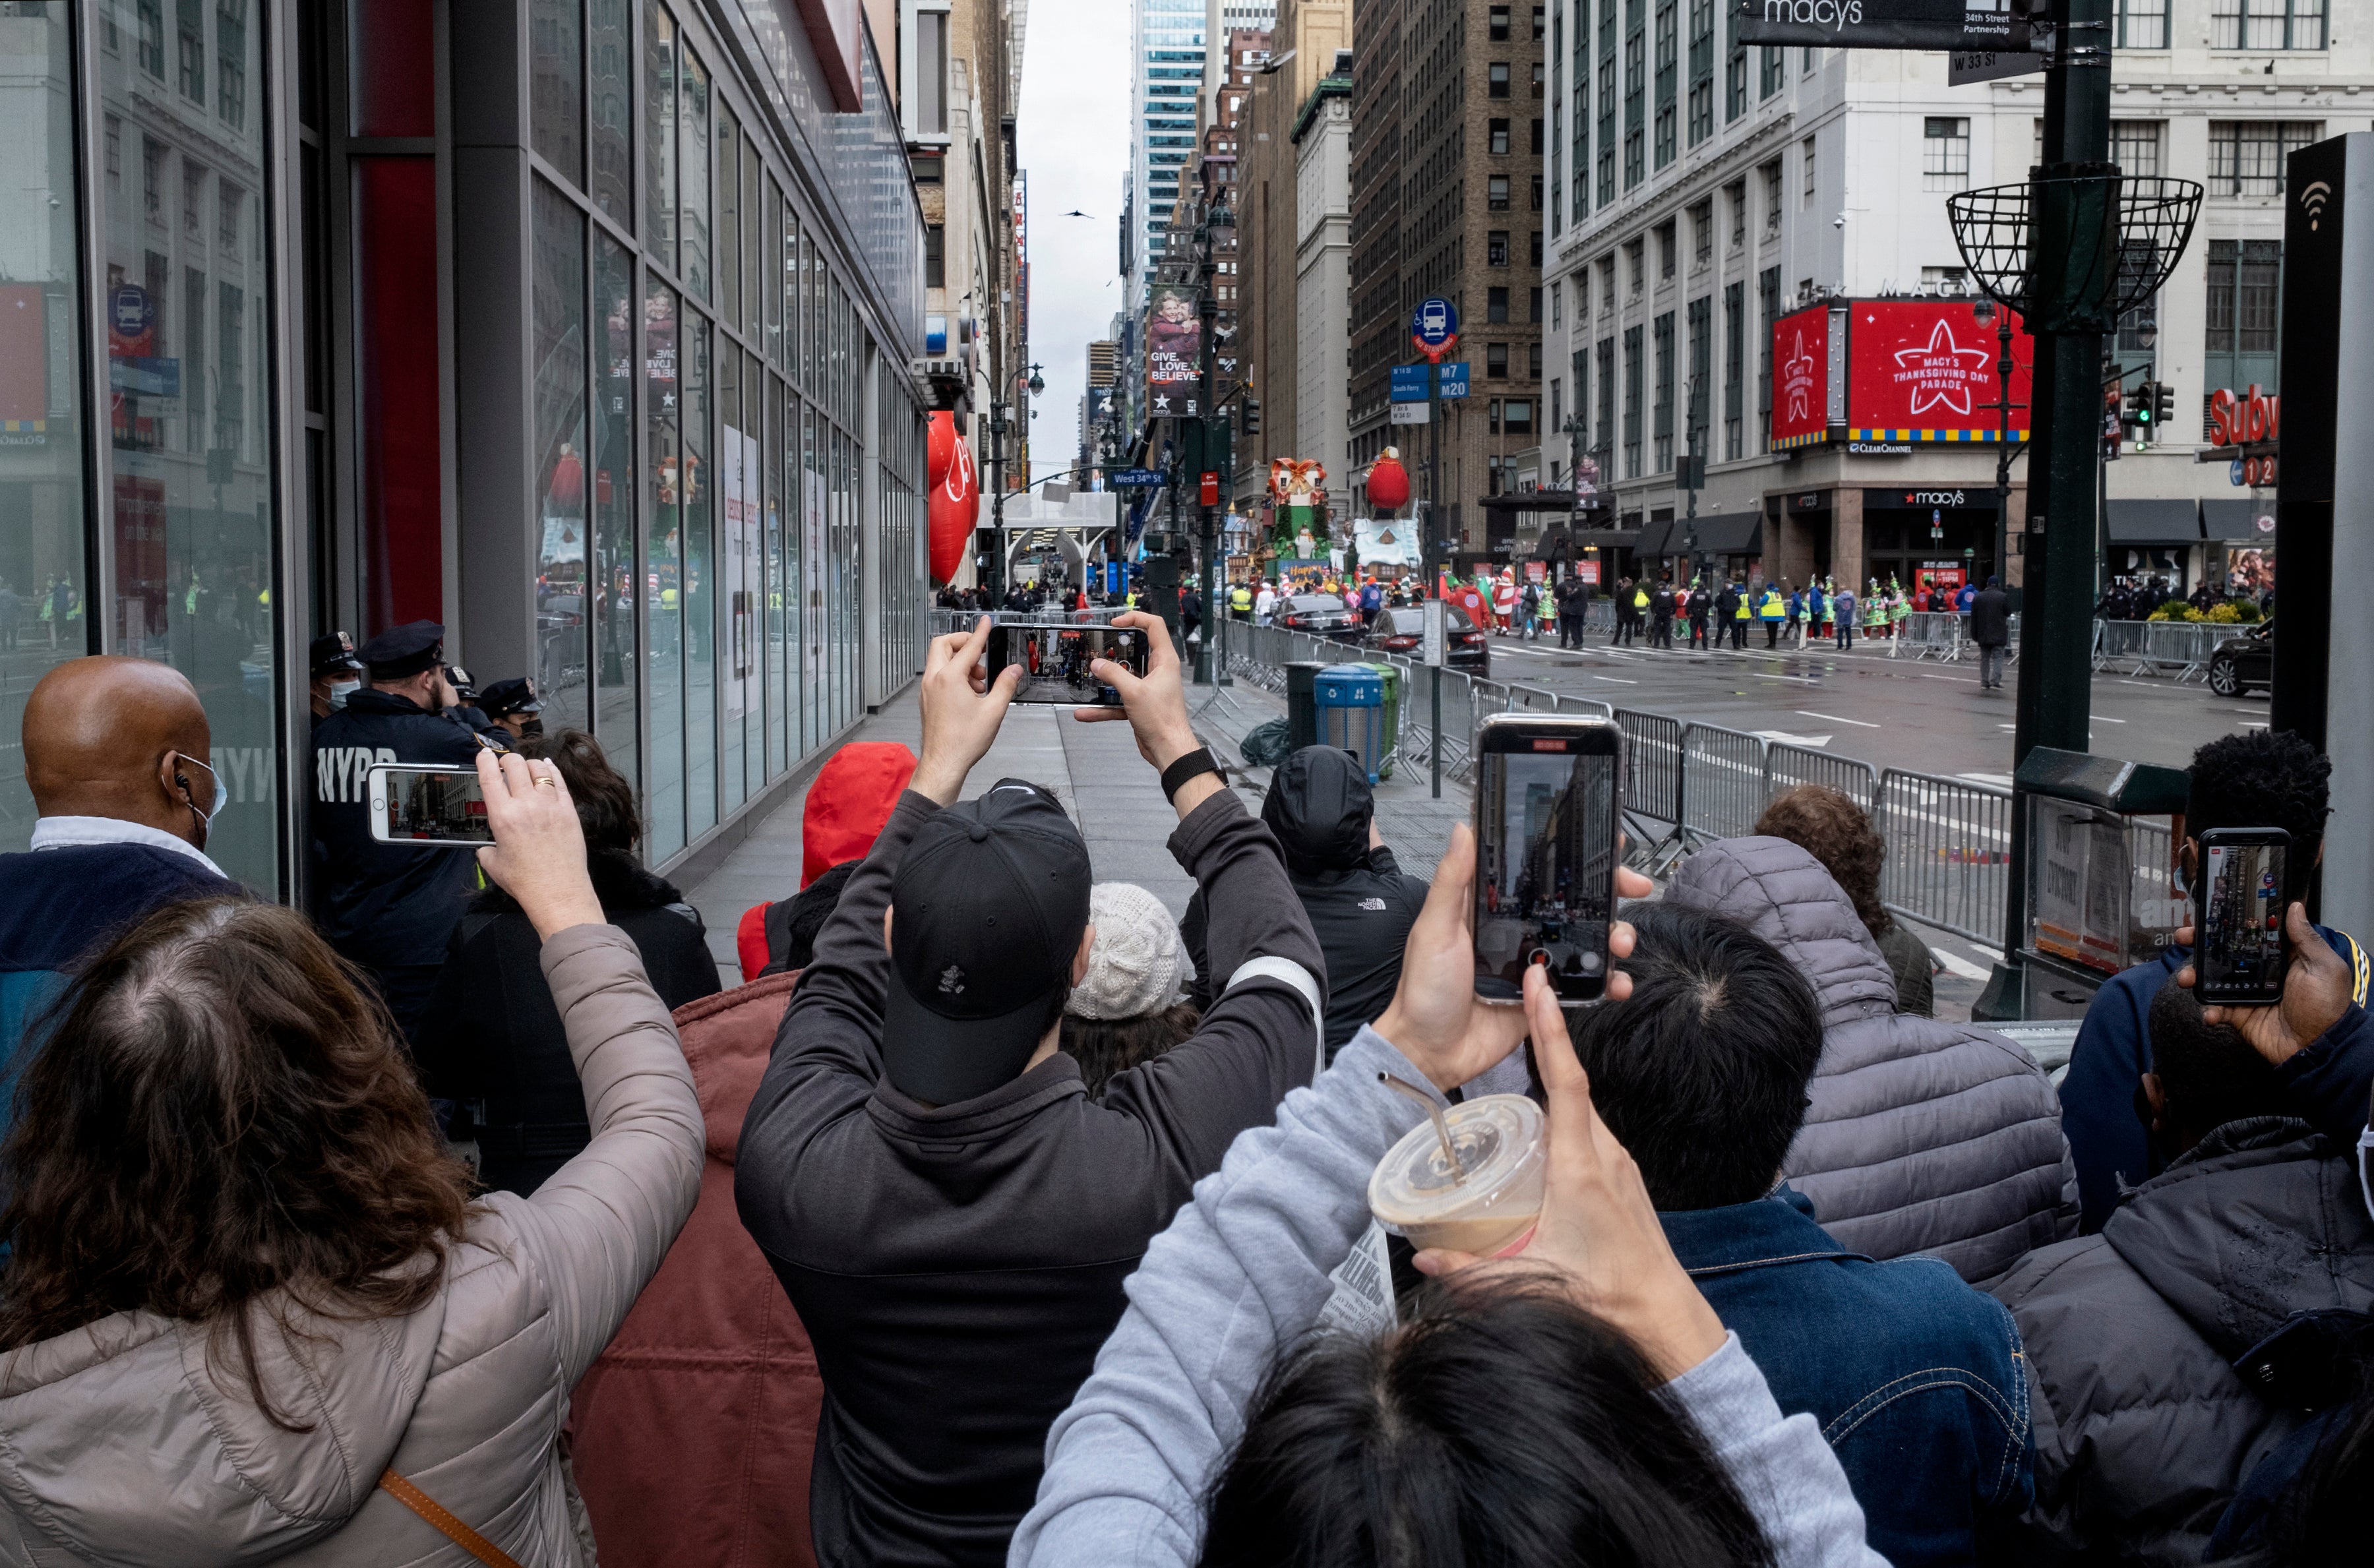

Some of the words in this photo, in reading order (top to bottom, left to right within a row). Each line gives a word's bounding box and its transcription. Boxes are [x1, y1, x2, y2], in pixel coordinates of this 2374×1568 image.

[1965, 13, 1983, 23] 34th
[1985, 14, 2010, 23] Street
[1964, 25, 2010, 35] Partnership
[1955, 57, 1964, 71] W
[1968, 55, 1982, 69] 33
[1984, 53, 1996, 66] St
[1415, 337, 1423, 347] NO
[1423, 337, 1454, 354] STANDING
[1151, 352, 1179, 361] GIVE.
[1159, 362, 1191, 371] LOVE.
[1924, 357, 1959, 367] MACY'S
[1152, 371, 1200, 381] BELIEVE.
[1442, 365, 1457, 378] M7
[1893, 368, 1966, 383] THANKSGIVING
[1970, 371, 1989, 384] DAY
[1442, 382, 1465, 396] M20
[1921, 380, 1962, 390] PARADE
[2265, 461, 2272, 479] 2
[1114, 474, 1135, 483] West
[1136, 474, 1151, 483] 34th
[1153, 474, 1161, 483] St
[1916, 489, 1964, 507] macy's
